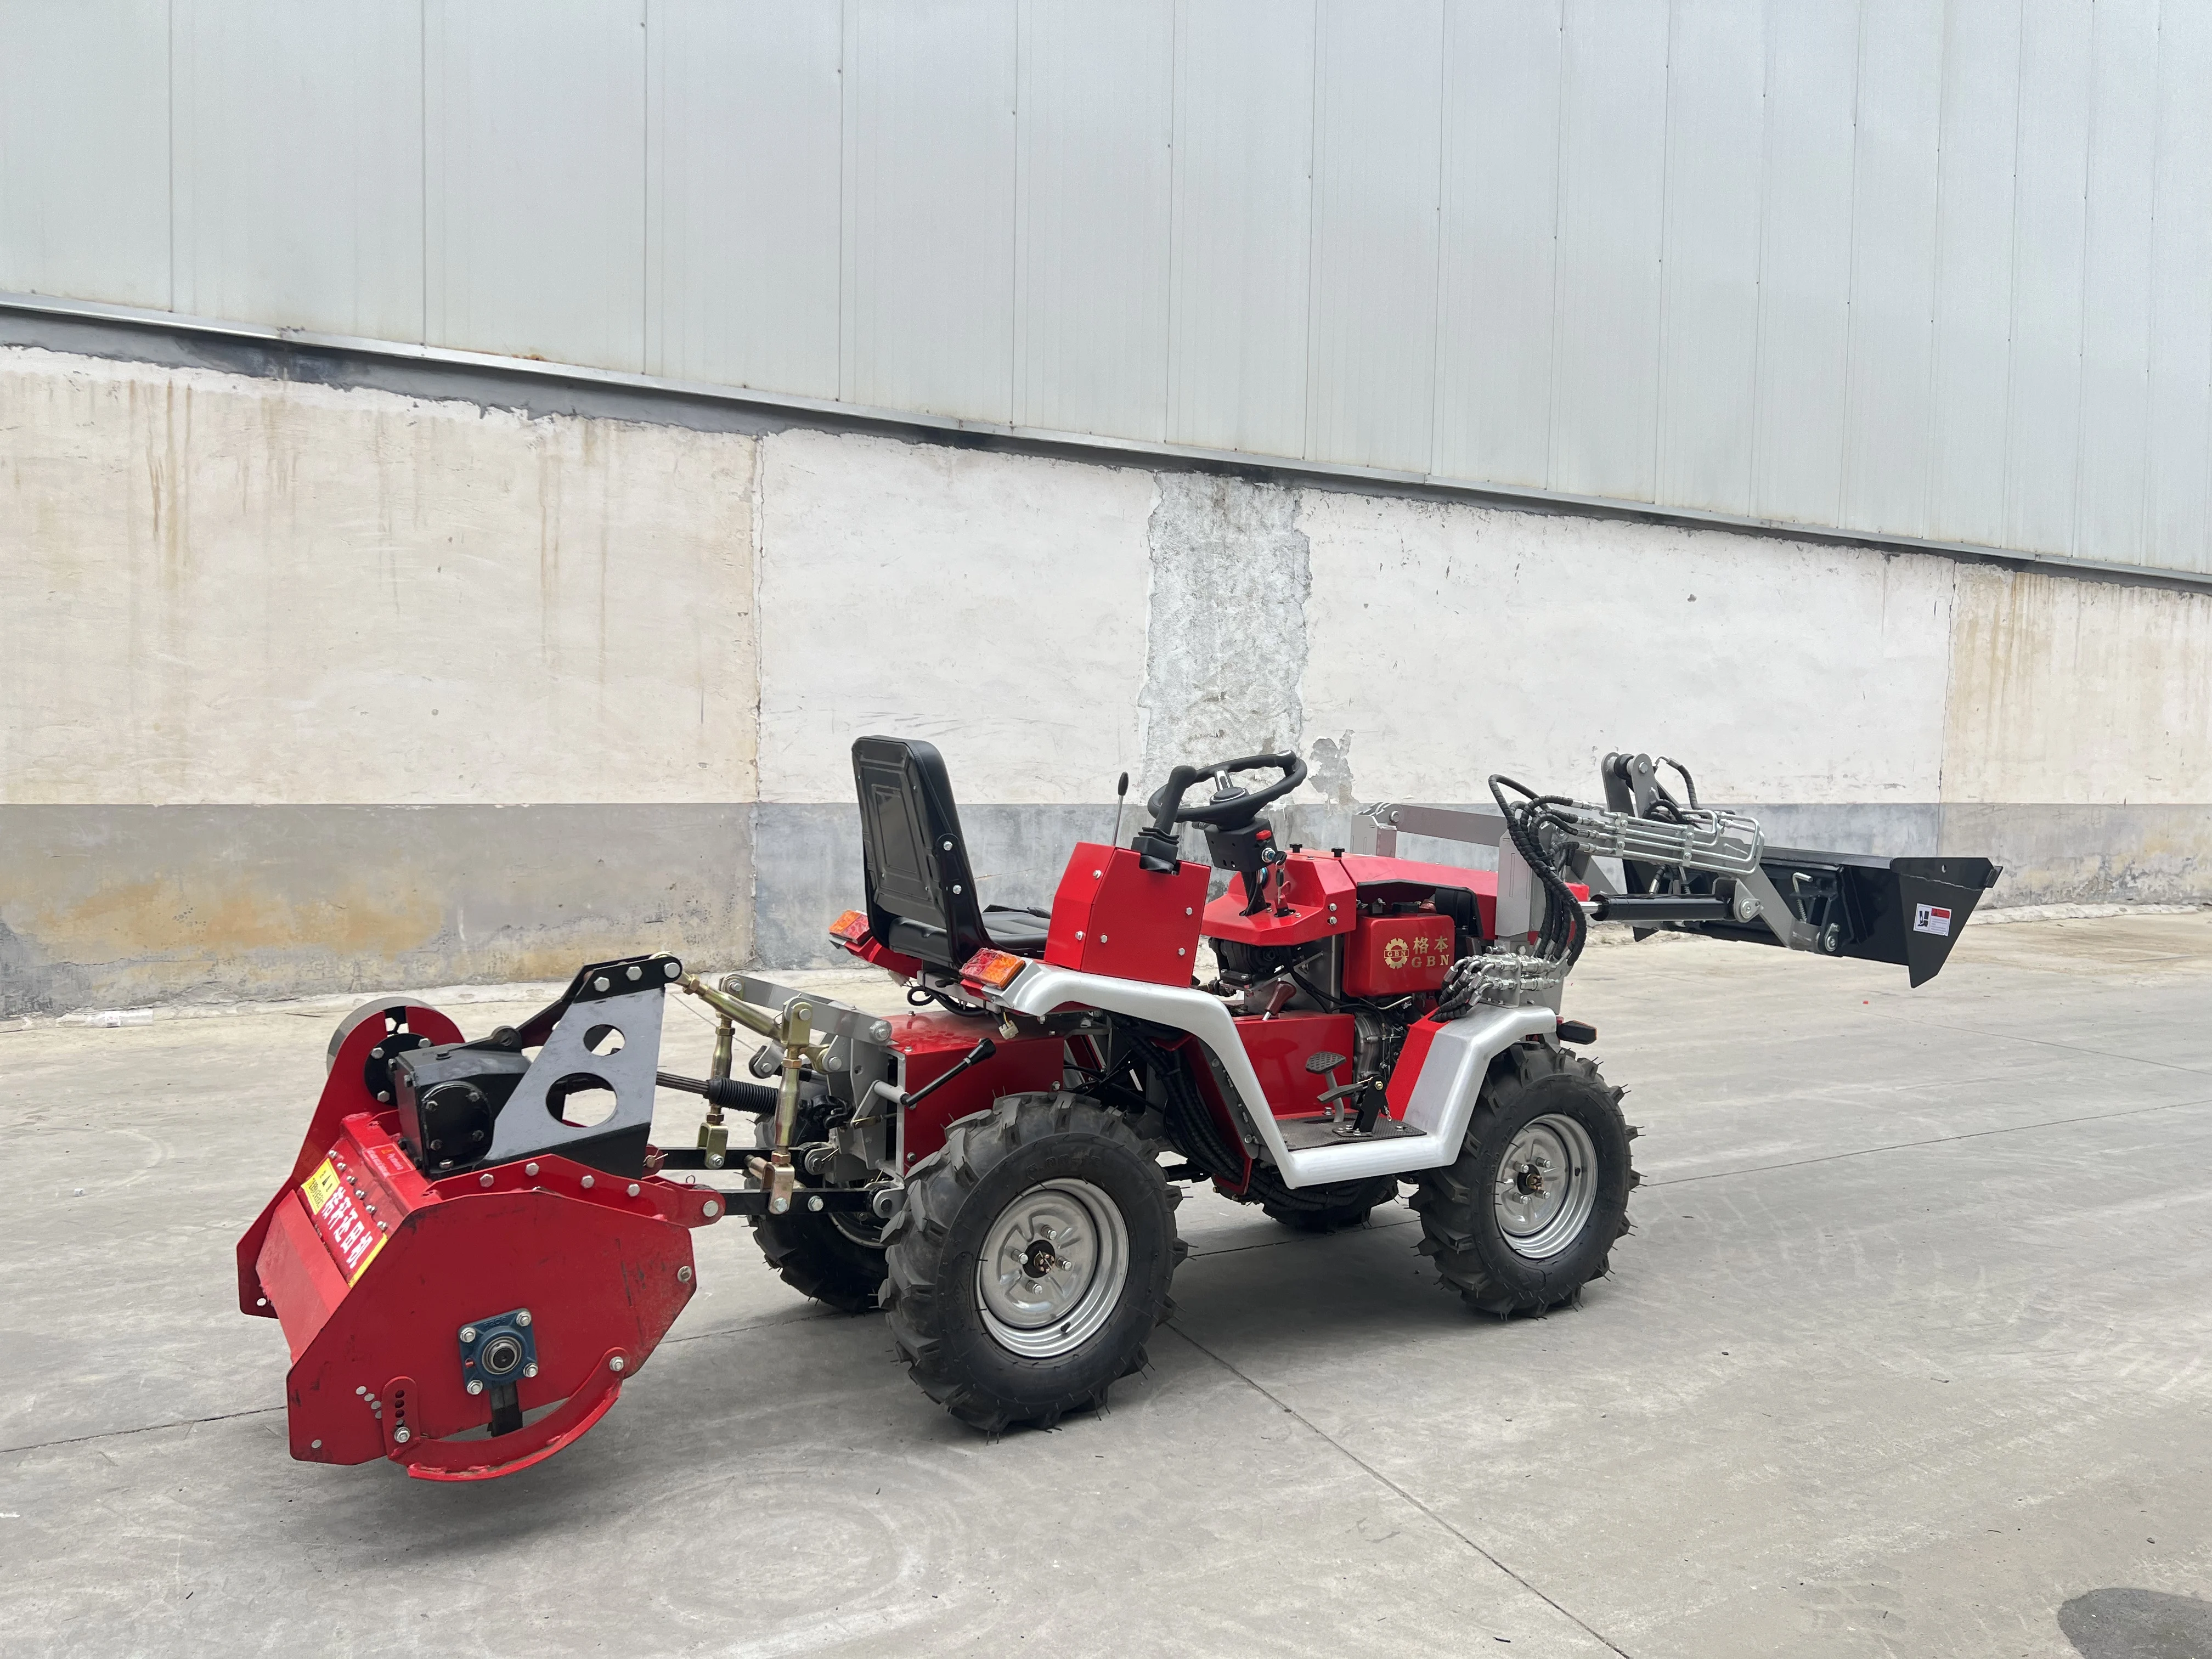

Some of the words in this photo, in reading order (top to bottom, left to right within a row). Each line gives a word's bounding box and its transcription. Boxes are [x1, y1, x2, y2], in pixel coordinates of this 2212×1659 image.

[1413, 935, 1448, 955] 格本
[1411, 954, 1449, 968] GBN
[321, 1187, 374, 1269] 秸秆还田机
